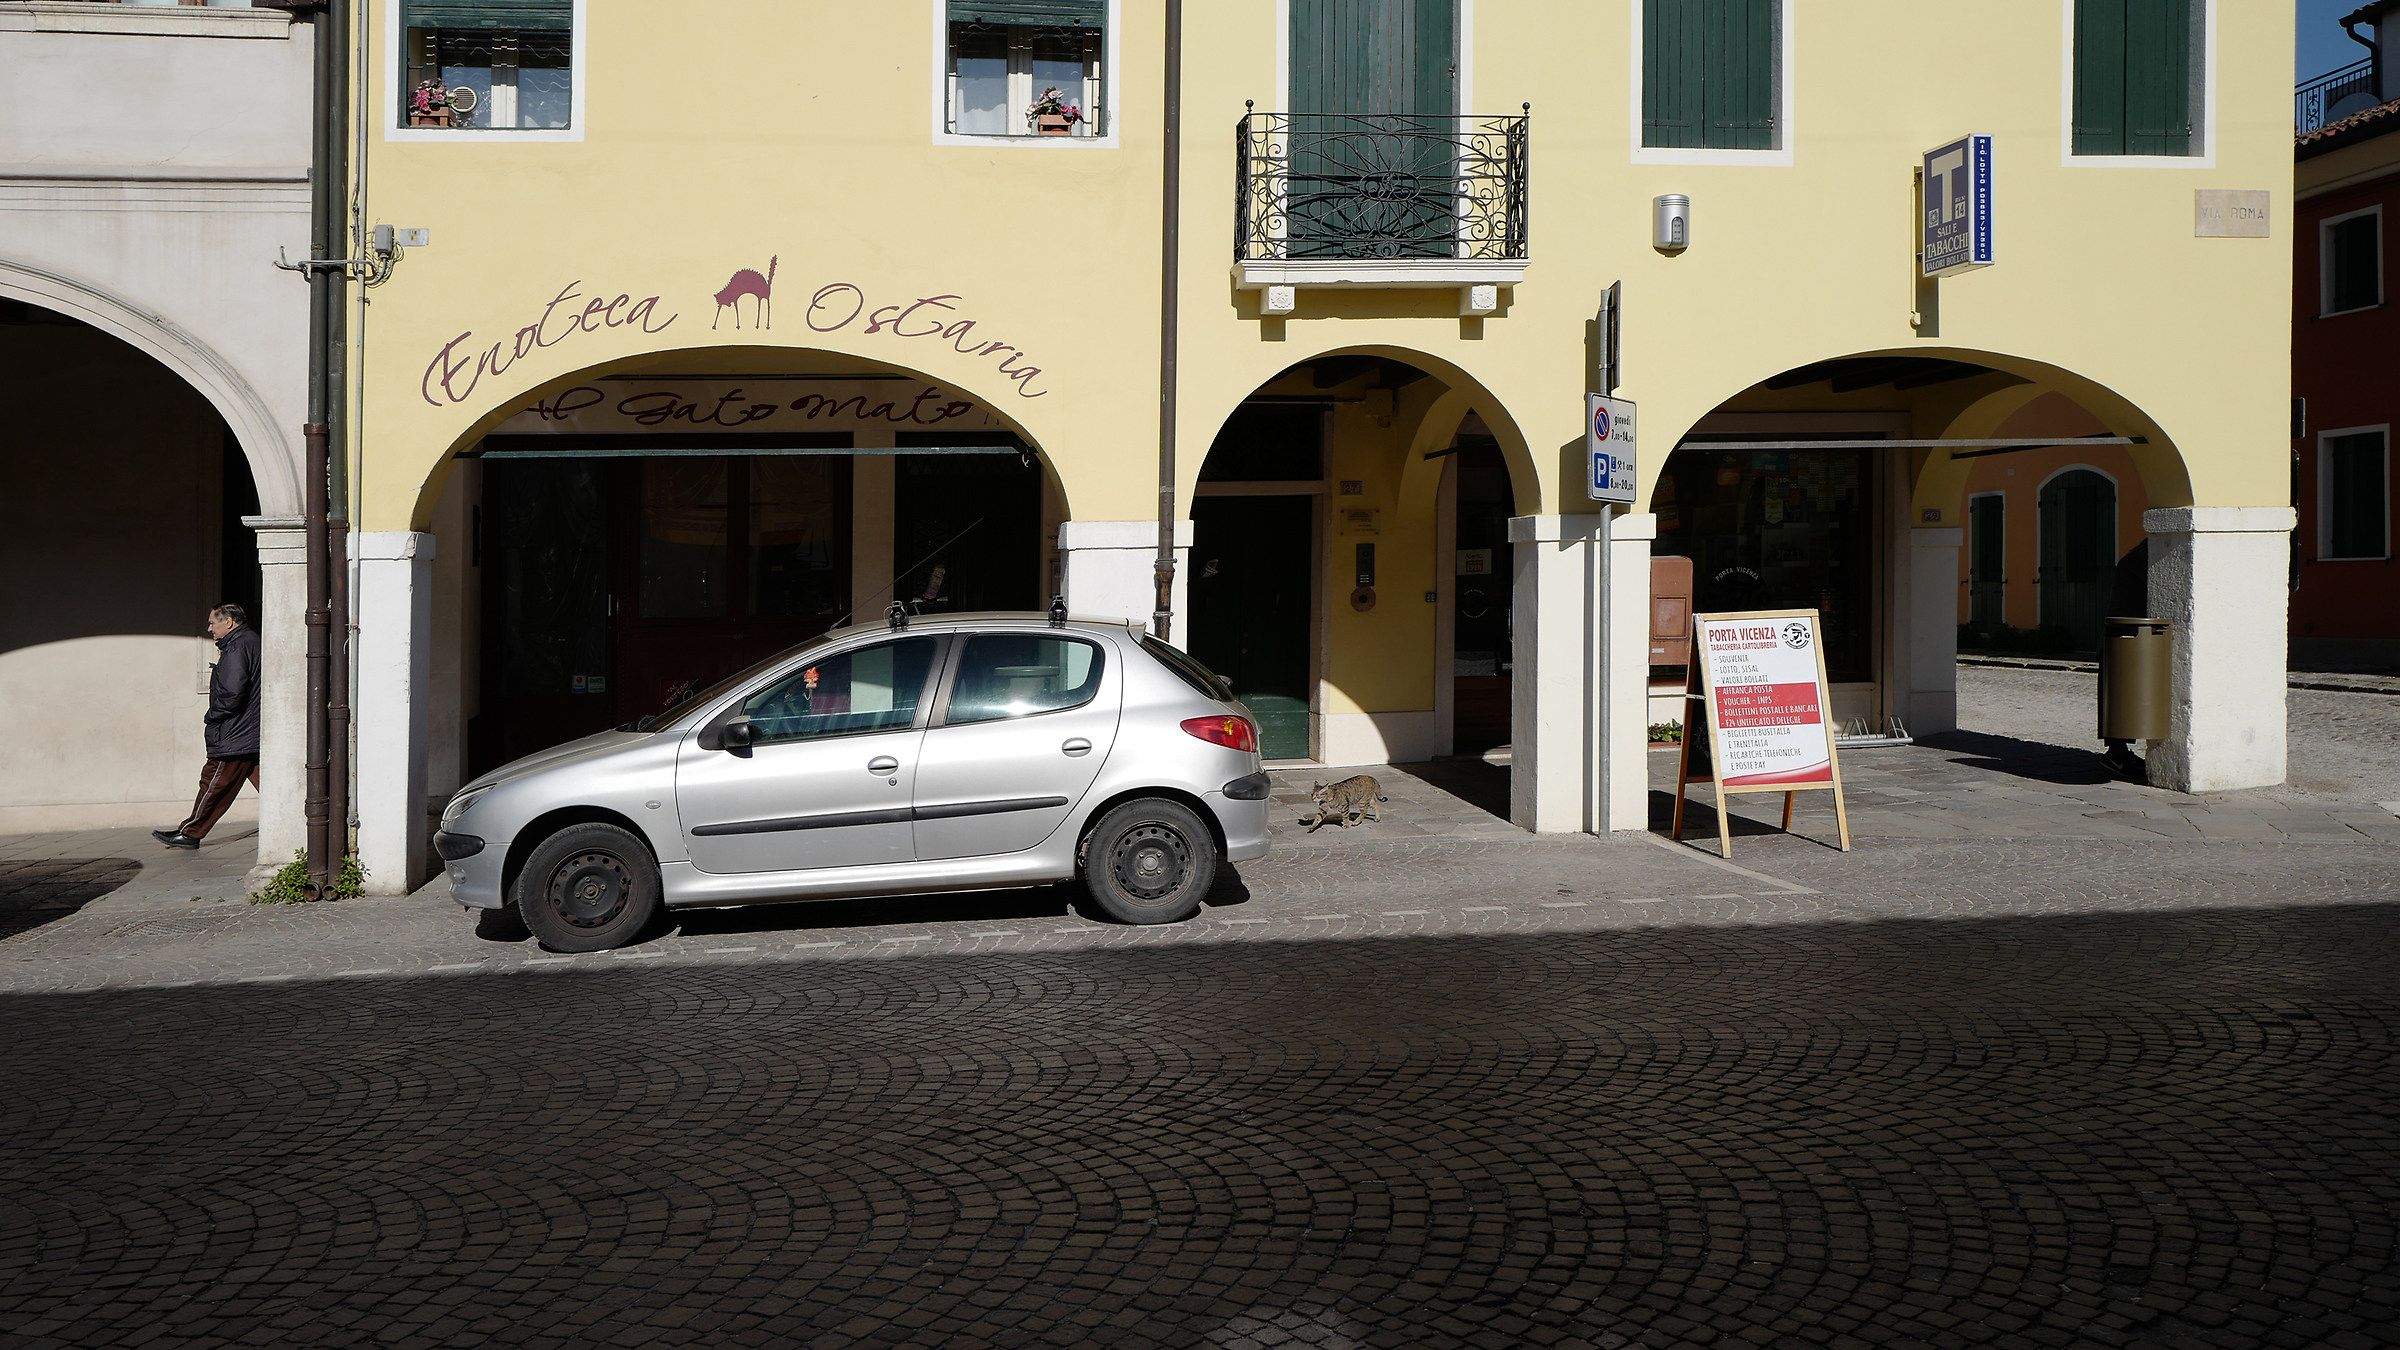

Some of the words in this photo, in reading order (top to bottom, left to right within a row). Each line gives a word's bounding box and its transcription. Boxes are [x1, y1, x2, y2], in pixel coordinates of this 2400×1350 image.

[2201, 207, 2221, 219] VIA
[2231, 207, 2264, 219] ROMA
[1937, 225, 1951, 238] SALI
[1953, 223, 1958, 232] E
[1927, 232, 1968, 259] TABACCHI
[1926, 259, 1946, 272] VALORI
[422, 280, 678, 406] Enoteca
[806, 282, 1047, 398] Ostaria
[617, 388, 778, 425] Gato
[1345, 484, 1357, 493] 27
[1926, 512, 1937, 520] 29
[1715, 567, 1734, 582] PORTA
[1736, 566, 1760, 581] VICENZA
[1709, 628, 1738, 642] PORTA
[1739, 626, 1777, 641] VICENZA
[1710, 643, 1742, 652] TABACCHERIA
[1742, 641, 1778, 650] CARTOLIBRERIA
[1719, 654, 1750, 663] SOUVENIR
[1742, 664, 1759, 673] SISAL
[1721, 676, 1743, 684] VALORI
[1745, 674, 1769, 683] BOLLATI
[1723, 686, 1753, 695] AFFRANCA
[1754, 685, 1773, 693] POSTA
[1723, 697, 1751, 706] VOUCHER
[1757, 695, 1773, 704] INPS
[1725, 707, 1759, 716] BOLLETTINI
[1760, 705, 1784, 715] POSTALI
[1790, 704, 1818, 713] BANCARI
[1726, 719, 1736, 727] F24
[1737, 717, 1771, 727] UNIFICATO
[1776, 715, 1801, 725] DELEGHE
[1727, 729, 1757, 738] BIGLIETTI
[1758, 727, 1791, 736] BUSITALIA
[1733, 739, 1769, 749] TRENITALIA
[1730, 750, 1762, 760] RICARICHE
[1764, 748, 1802, 758] TELEFONICHE
[1735, 761, 1753, 770] POSTE
[1754, 760, 1766, 769] PAY
